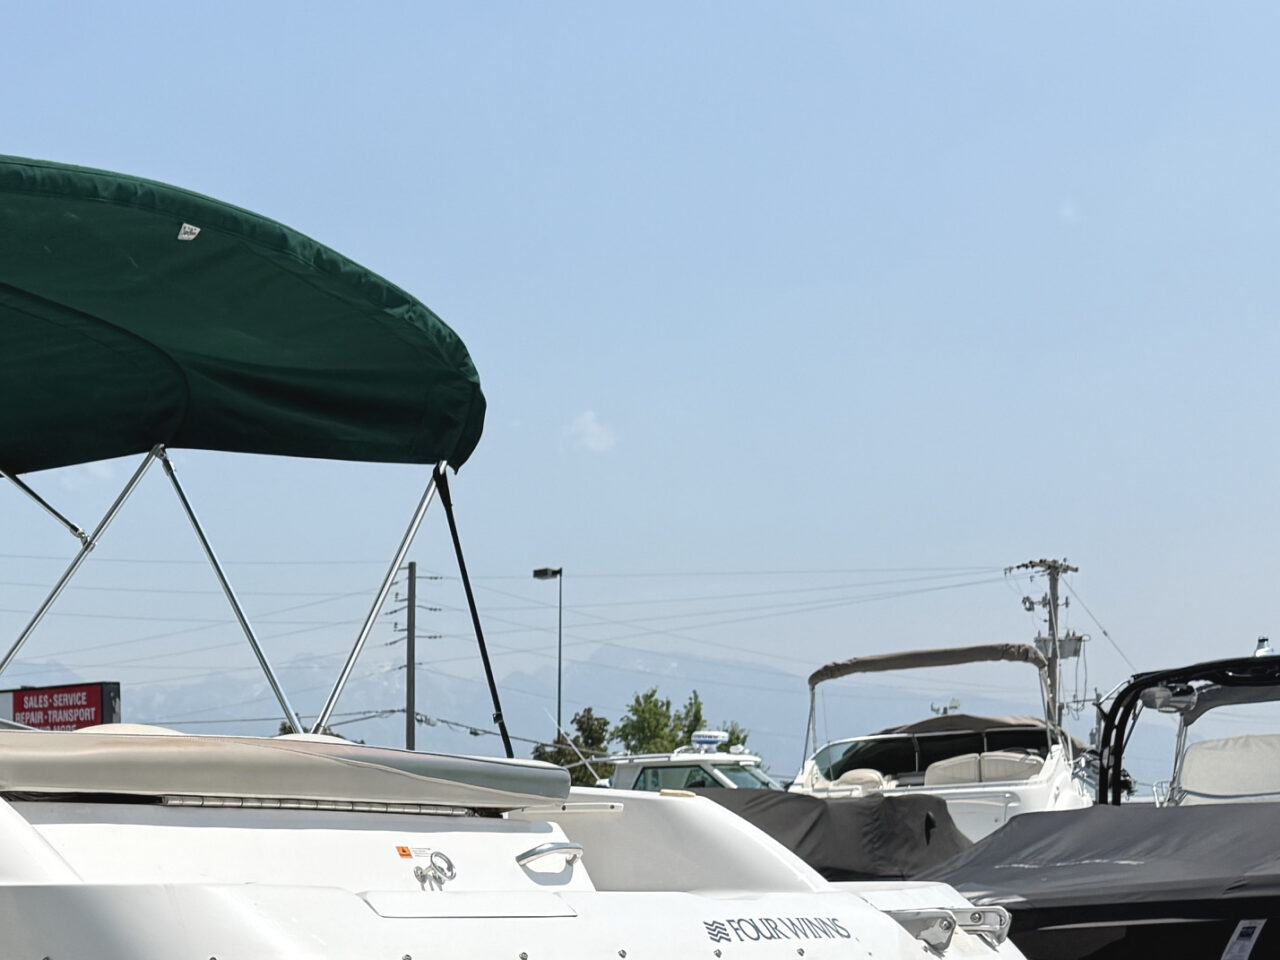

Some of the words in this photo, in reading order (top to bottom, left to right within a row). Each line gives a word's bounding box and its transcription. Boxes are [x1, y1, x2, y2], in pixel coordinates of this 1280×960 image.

[23, 695, 49, 709] SALES
[53, 692, 87, 707] SERVICE
[15, 711, 44, 724] REPAIR
[48, 707, 96, 723] TRANSPORT
[726, 918, 791, 942] FOUR
[776, 917, 851, 940] WINNS
